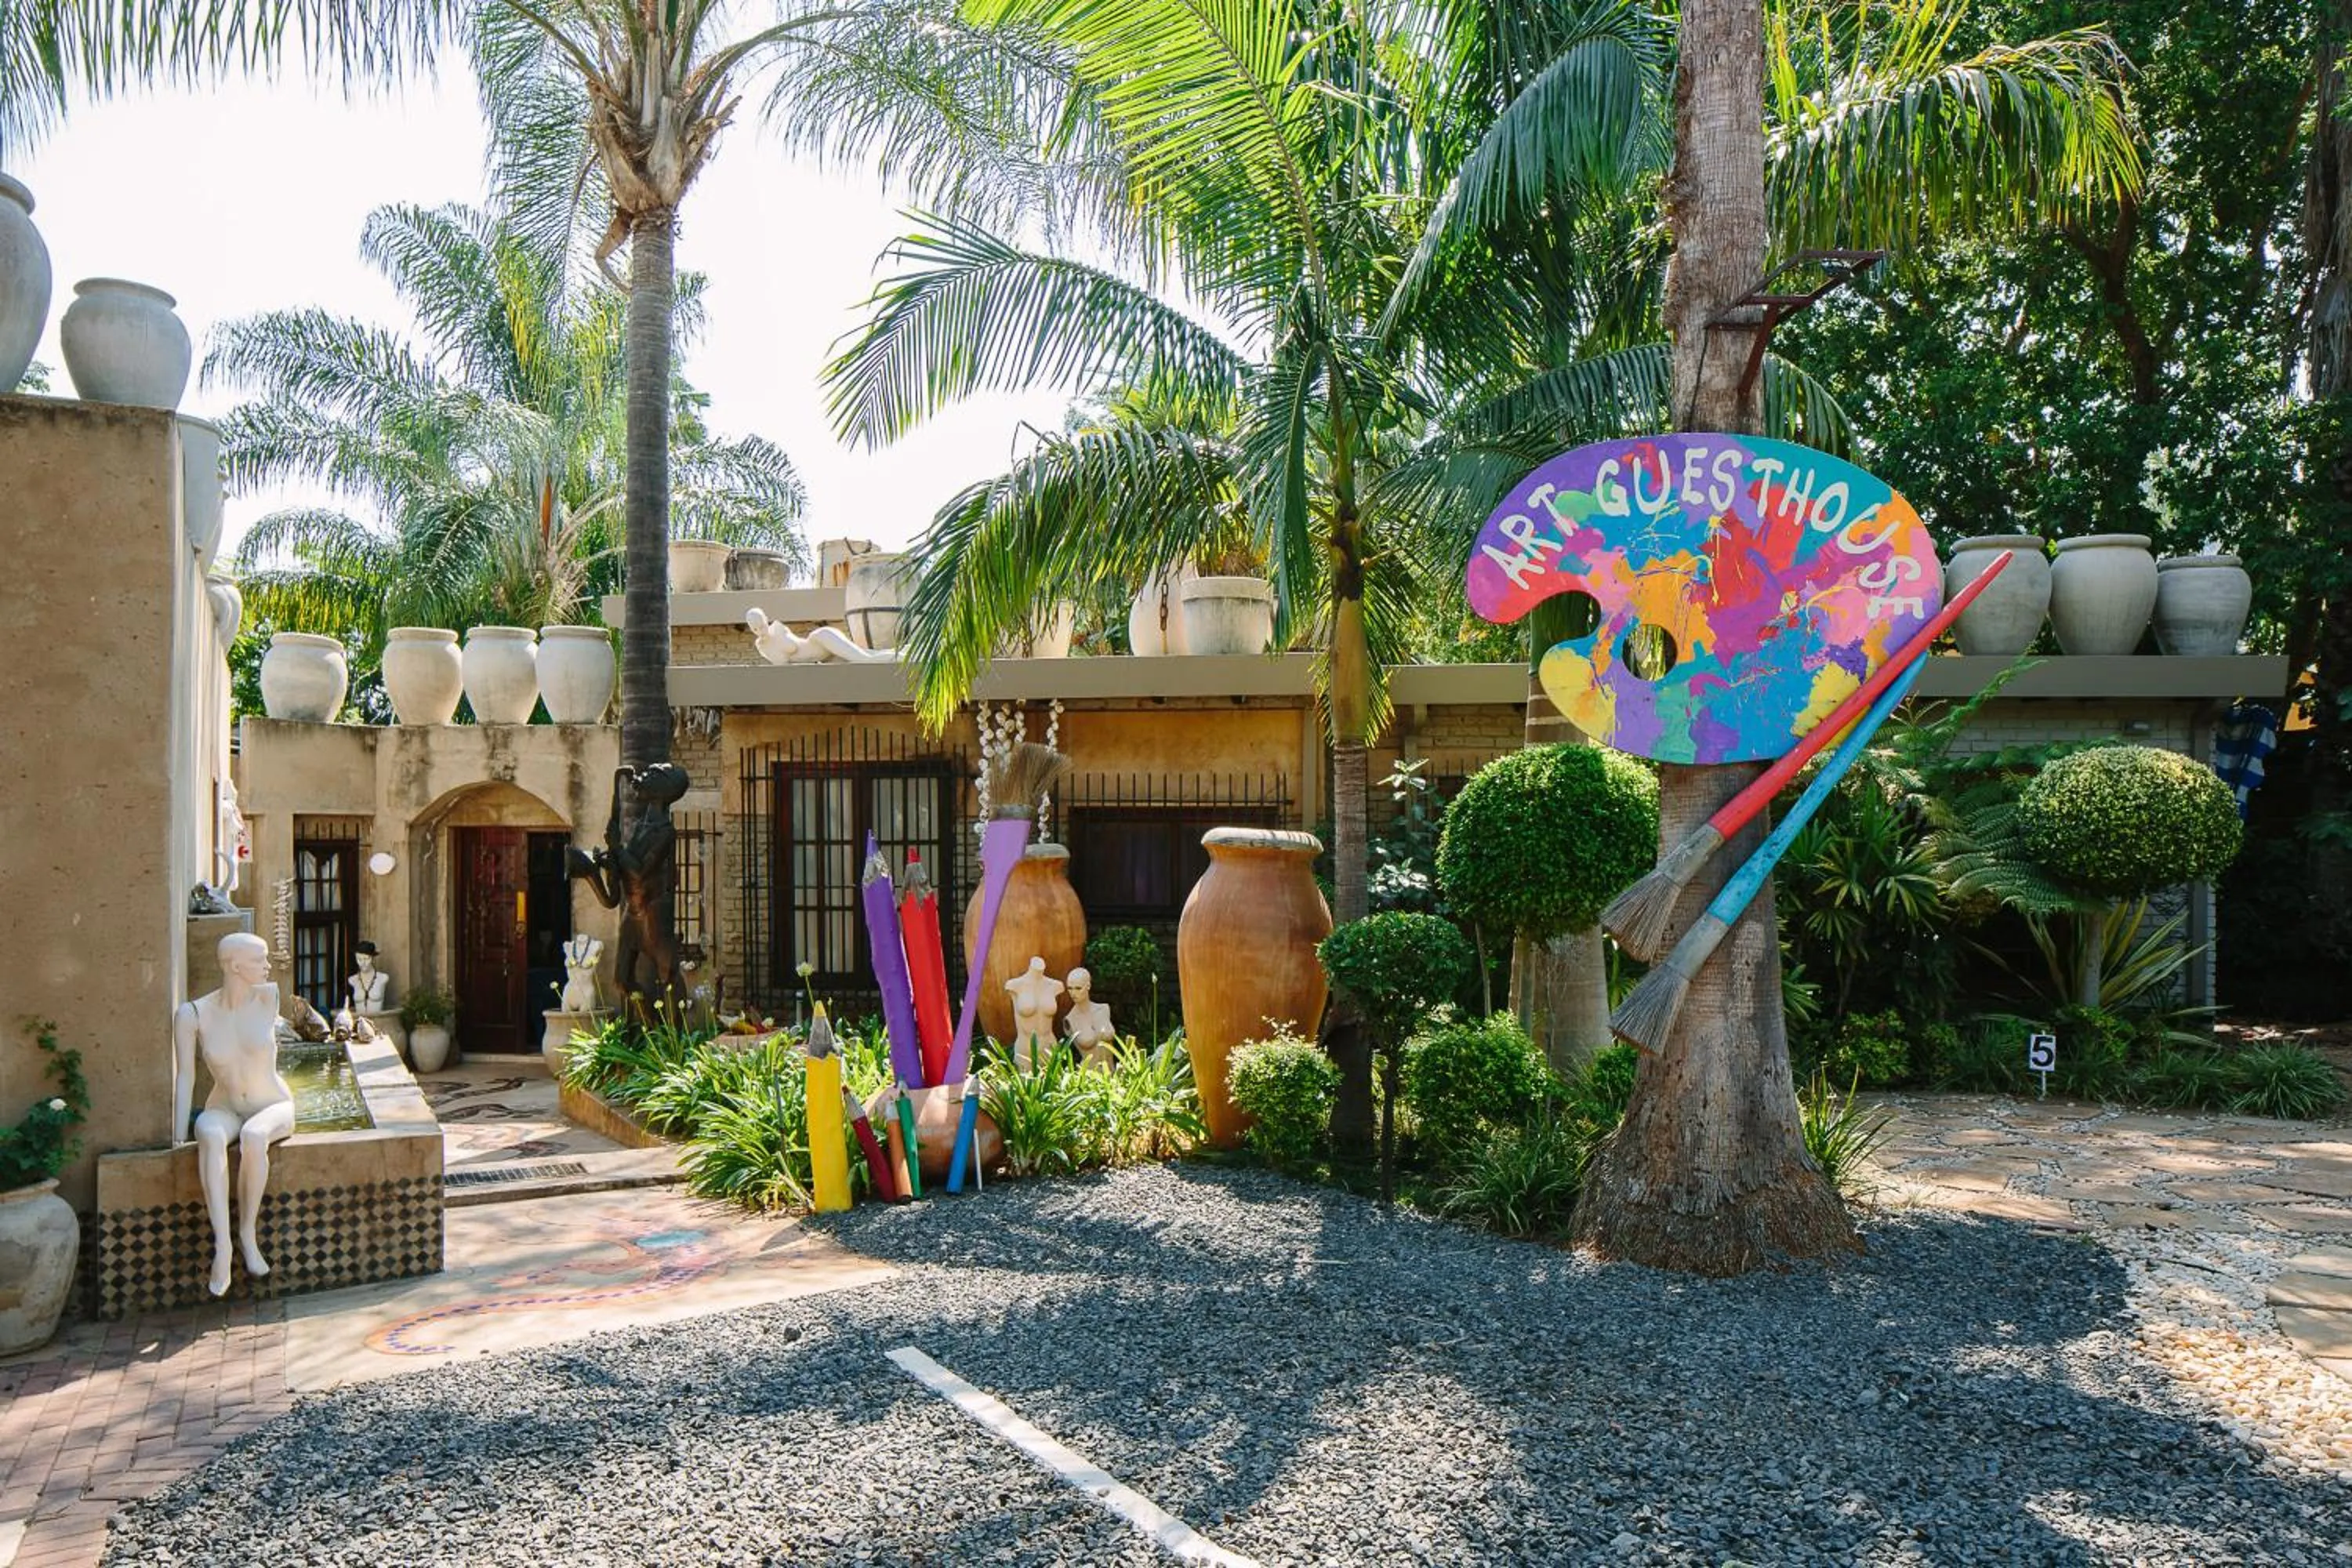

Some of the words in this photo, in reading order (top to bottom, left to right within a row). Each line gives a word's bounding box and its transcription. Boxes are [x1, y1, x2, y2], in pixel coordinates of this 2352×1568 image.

[1482, 483, 1578, 590] ART
[1596, 448, 1924, 619] GUESTHOUSE
[2031, 1036, 2054, 1067] 5
